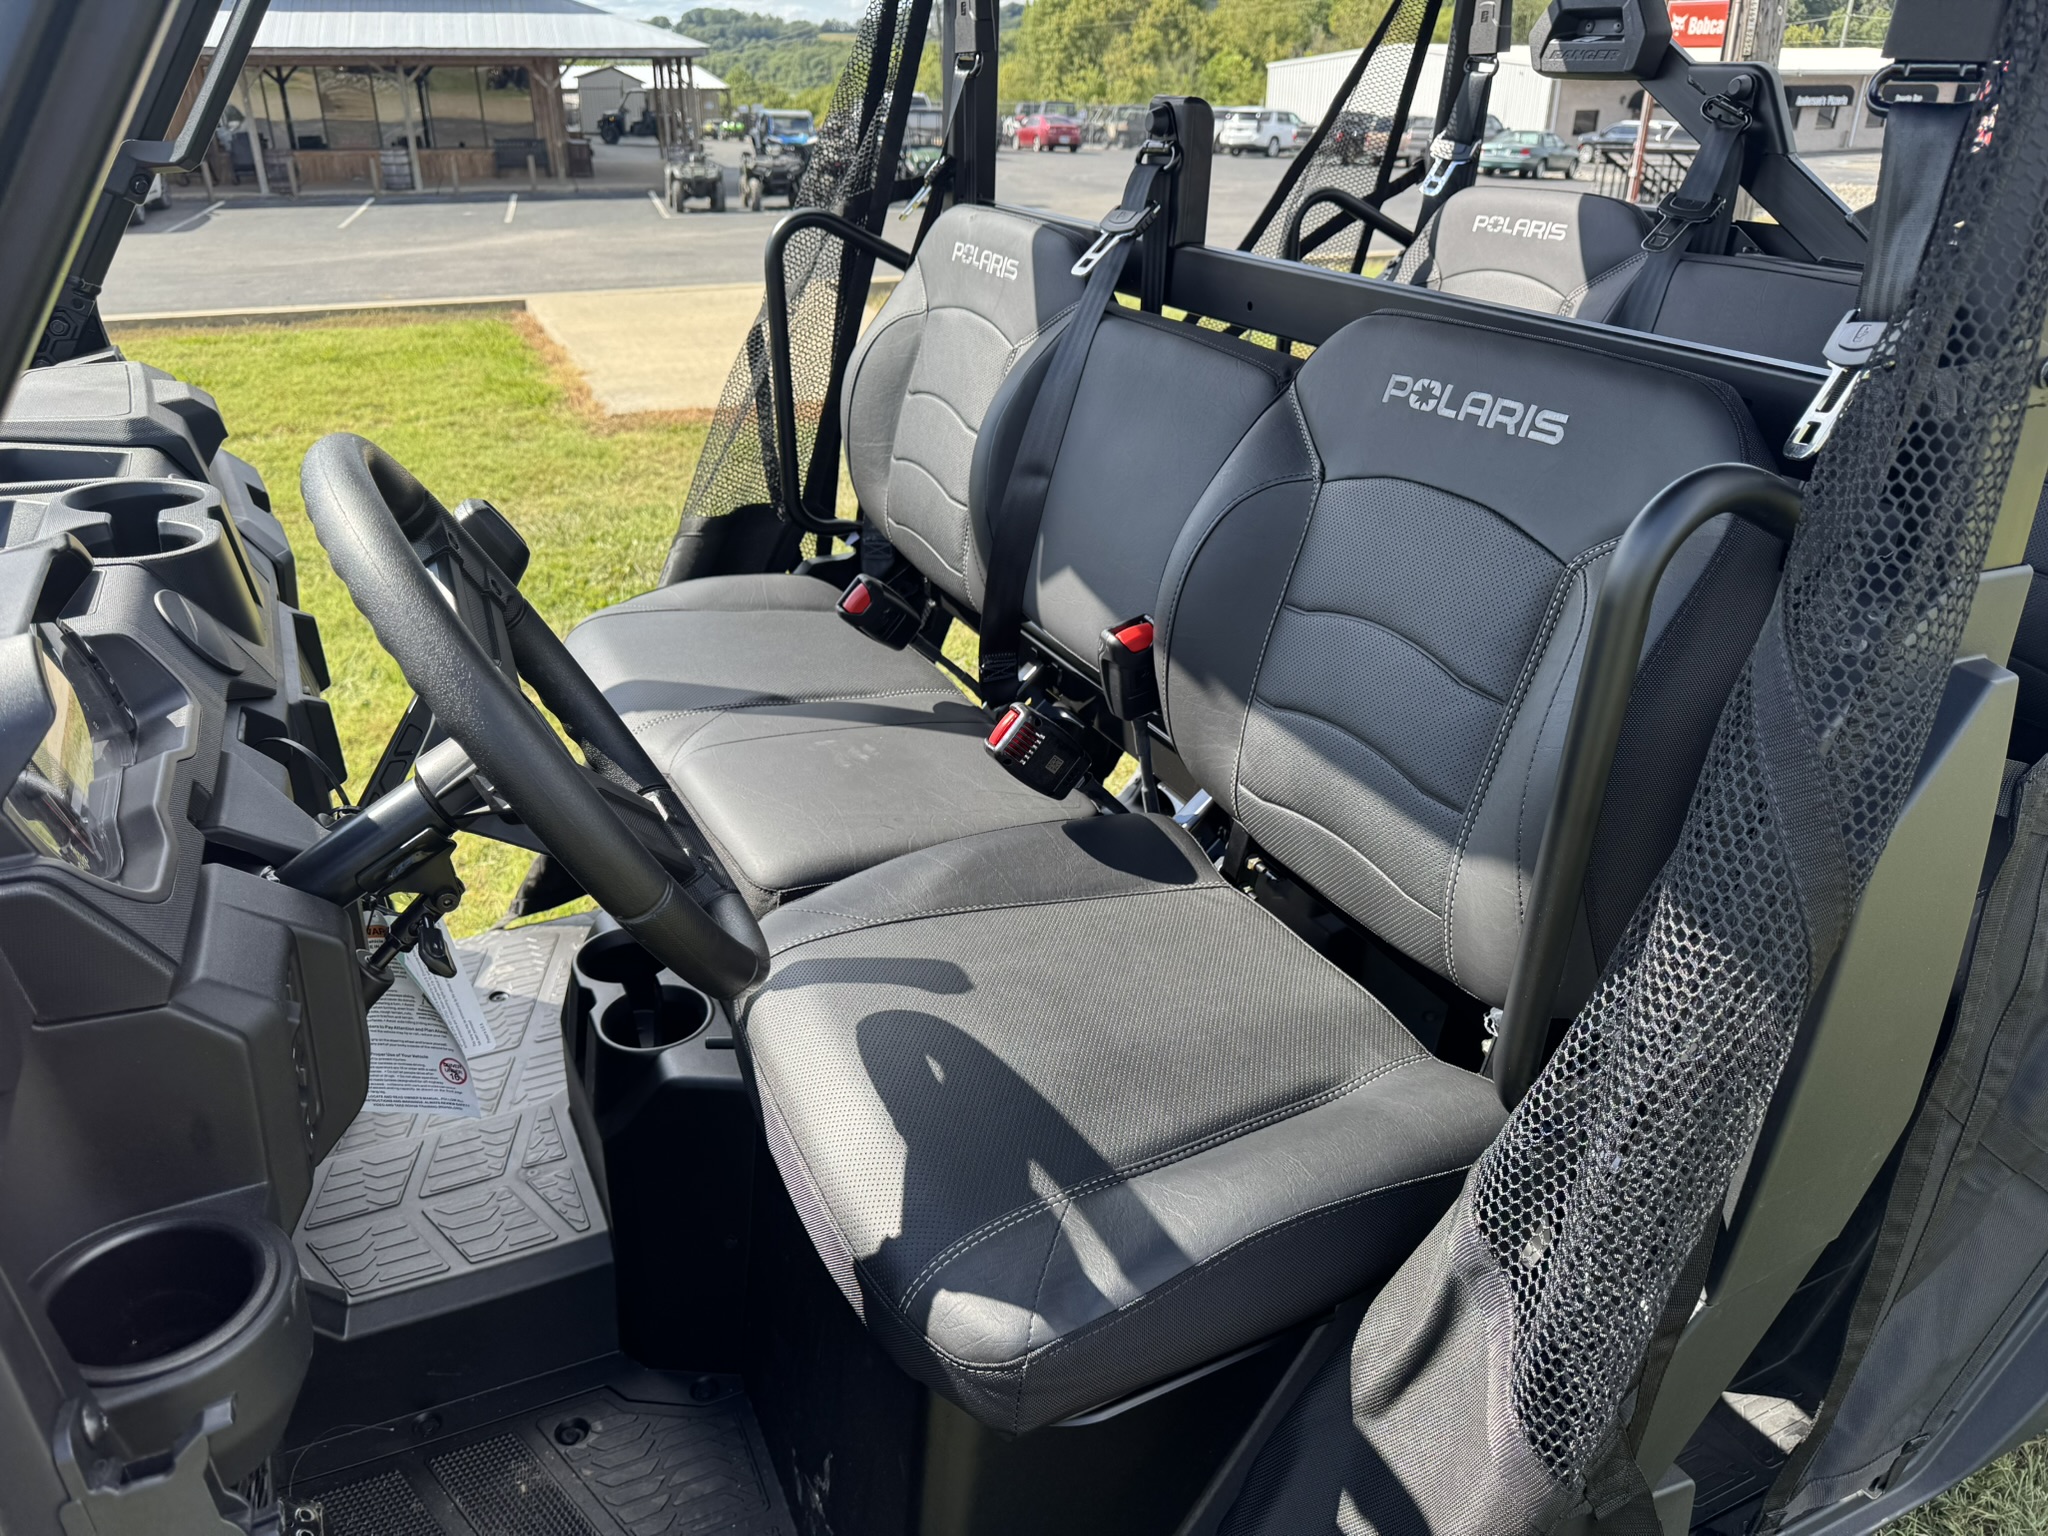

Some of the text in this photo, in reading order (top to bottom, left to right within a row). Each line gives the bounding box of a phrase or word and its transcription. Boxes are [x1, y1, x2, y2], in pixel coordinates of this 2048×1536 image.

[1687, 15, 1726, 35] Bobca
[1549, 50, 1621, 61] RANGER
[1472, 214, 1569, 241] POLARIS
[951, 241, 1020, 280] POLARIS
[1381, 373, 1570, 445] POLARIS
